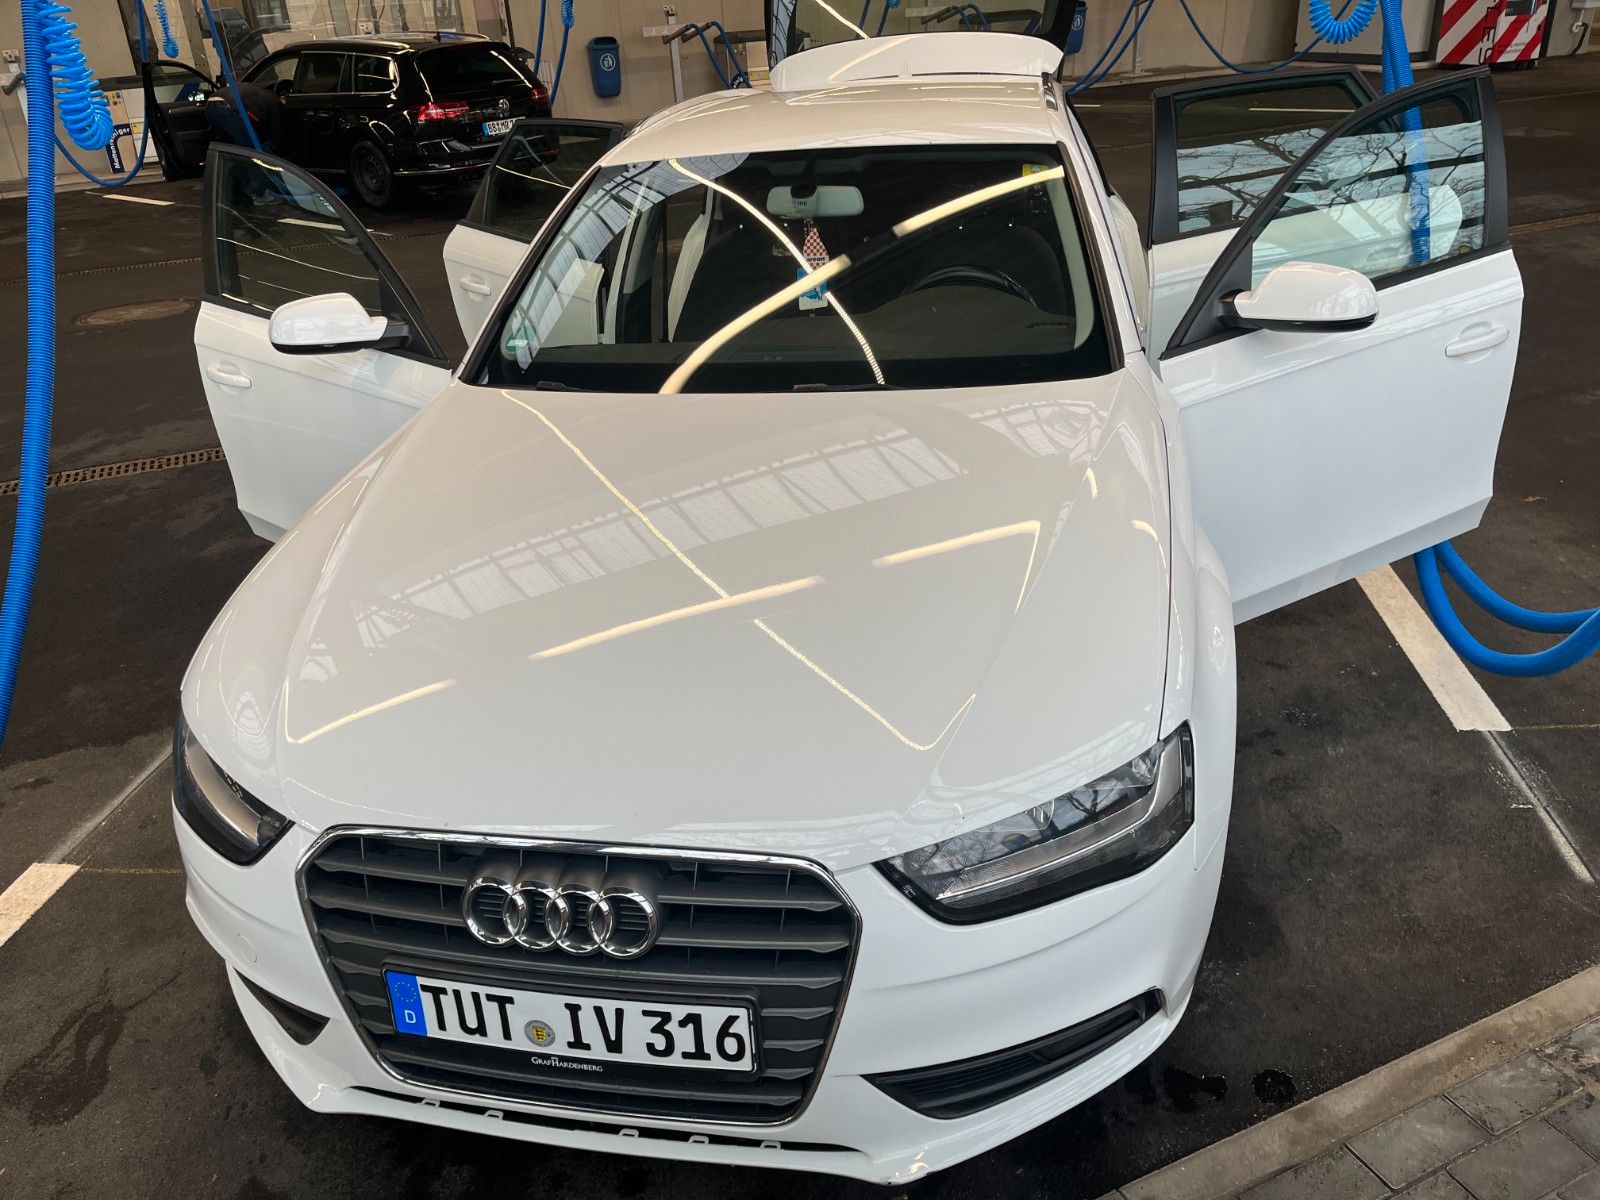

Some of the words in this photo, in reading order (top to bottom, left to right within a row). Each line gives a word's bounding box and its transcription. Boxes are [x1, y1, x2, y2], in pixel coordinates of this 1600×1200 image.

[405, 1010, 416, 1024] D
[420, 984, 515, 1041] TUT
[564, 1003, 624, 1054] IV
[641, 1009, 746, 1062] 316
